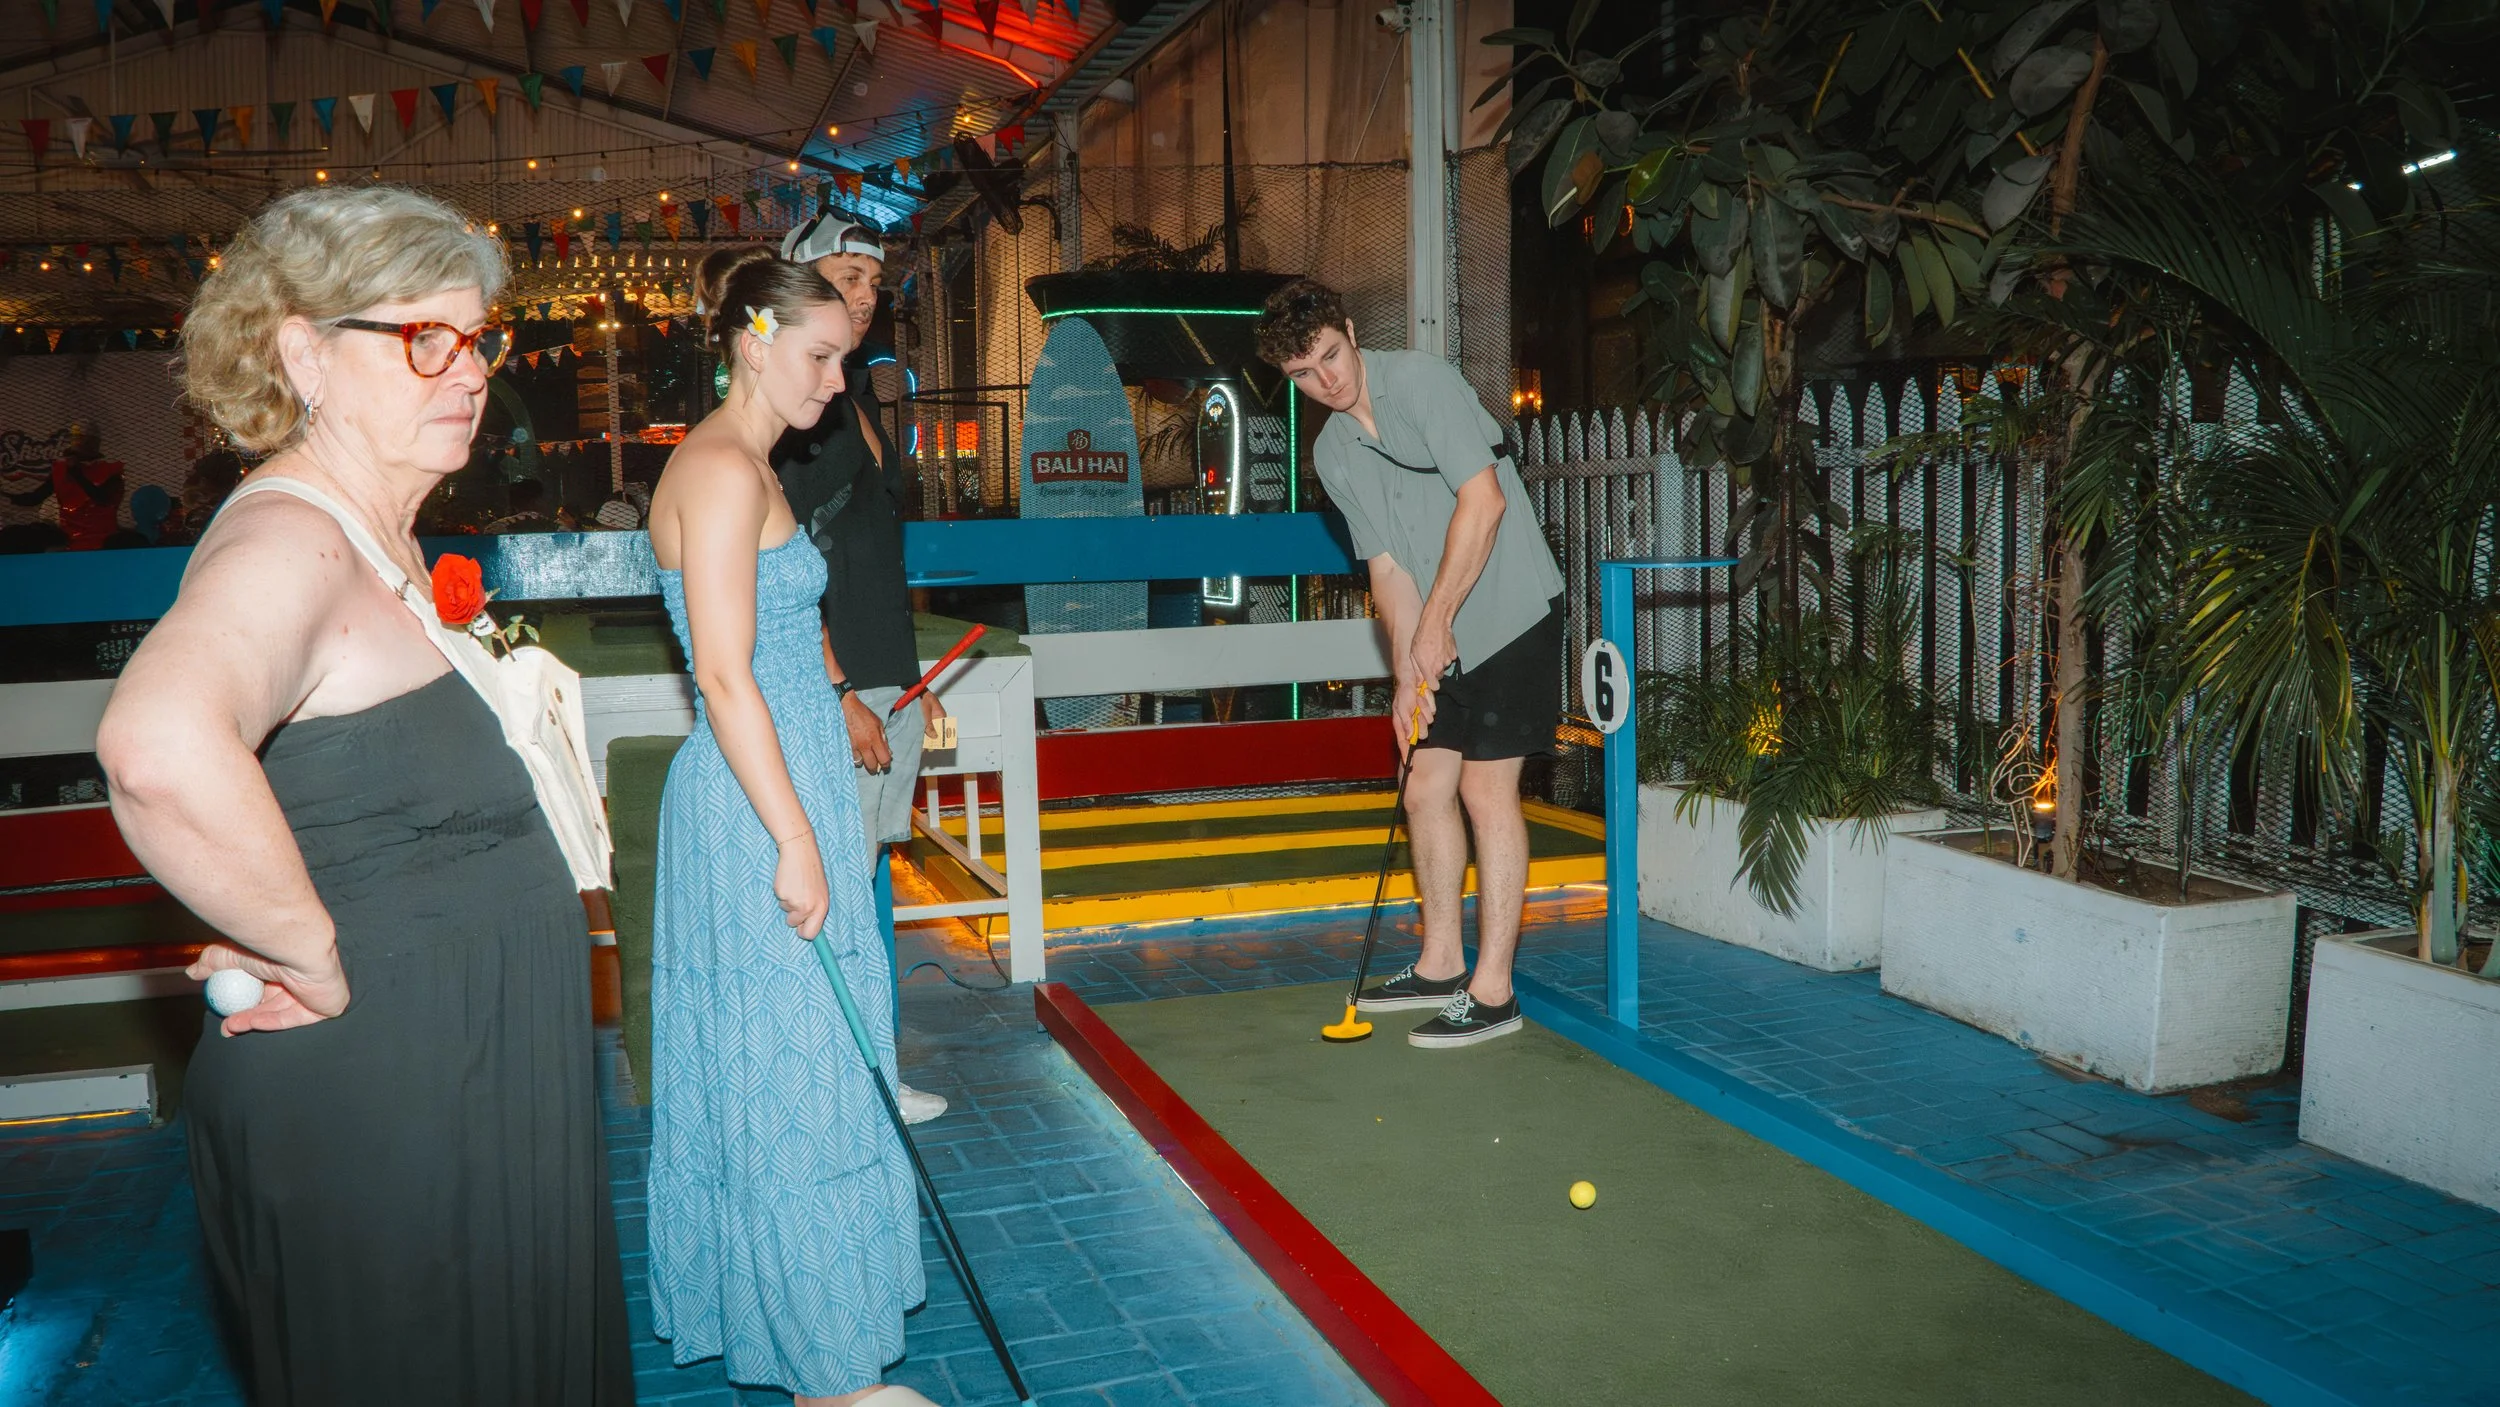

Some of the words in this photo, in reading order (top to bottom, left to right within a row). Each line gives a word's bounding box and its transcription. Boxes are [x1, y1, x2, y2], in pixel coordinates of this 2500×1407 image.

[1037, 457, 1083, 474] BALI
[1088, 457, 1124, 474] HAI
[1595, 650, 1614, 721] 6
